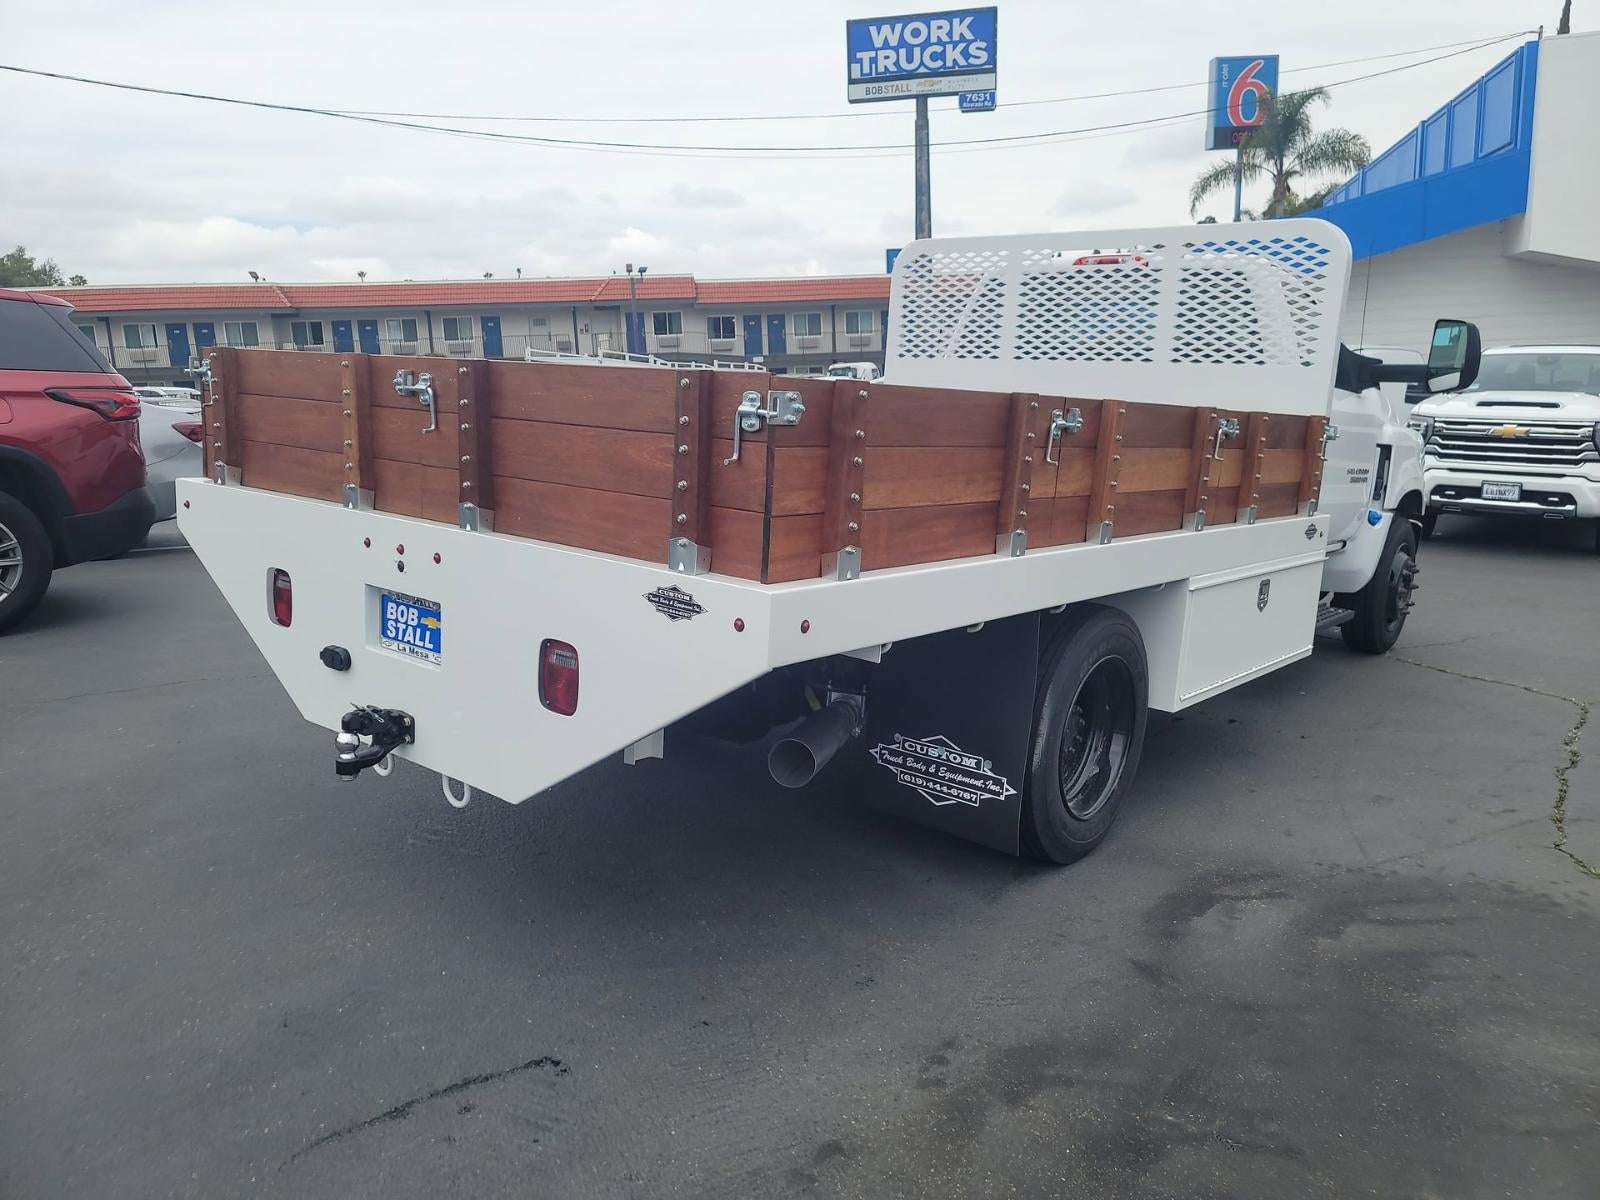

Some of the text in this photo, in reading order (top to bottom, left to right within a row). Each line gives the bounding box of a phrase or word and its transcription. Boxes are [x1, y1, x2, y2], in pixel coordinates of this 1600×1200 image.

[869, 16, 975, 48] WORK
[856, 41, 989, 74] TRUCKS
[965, 93, 991, 102] 7631
[1227, 59, 1268, 127] 6
[387, 602, 419, 626] BOB
[387, 620, 434, 650] STALL
[397, 644, 429, 659] La Mesa
[904, 741, 978, 768] CUSTOM
[881, 750, 1002, 793] Truck Body & Equipment, Inc.
